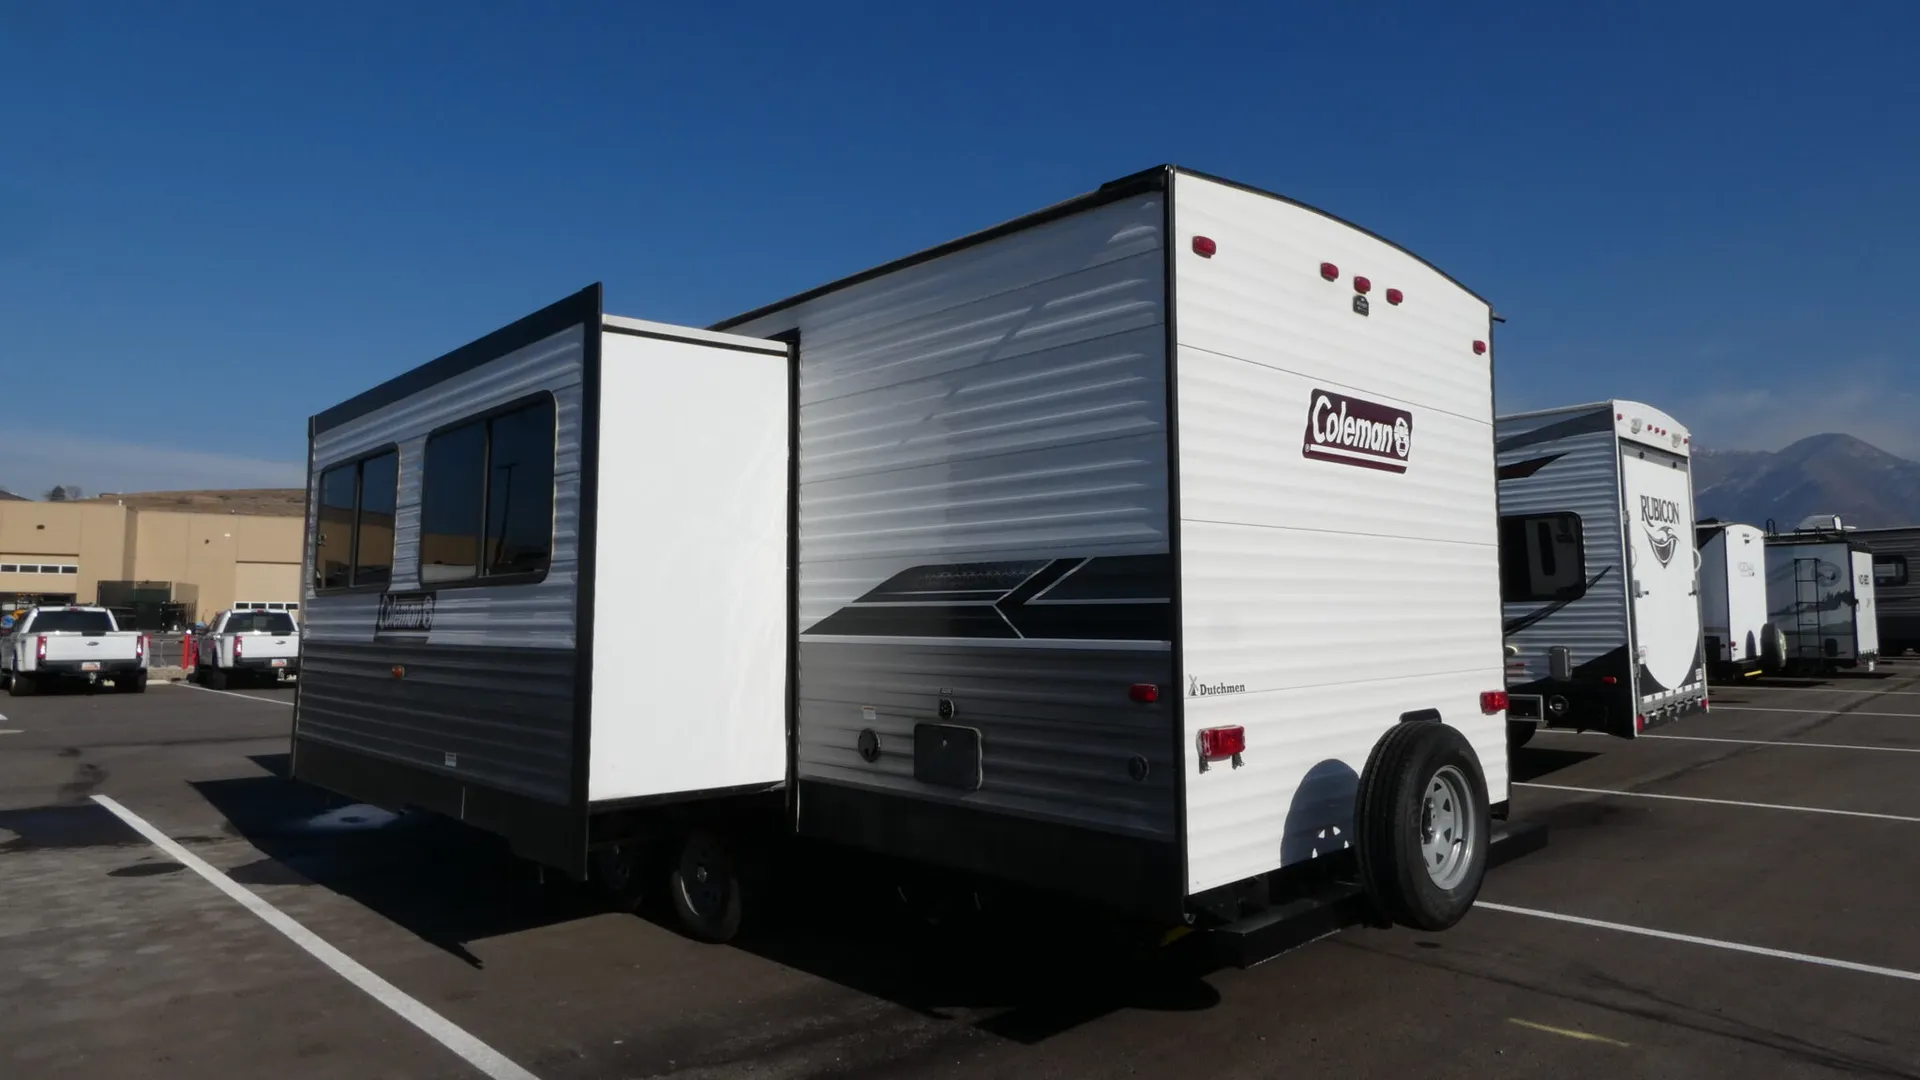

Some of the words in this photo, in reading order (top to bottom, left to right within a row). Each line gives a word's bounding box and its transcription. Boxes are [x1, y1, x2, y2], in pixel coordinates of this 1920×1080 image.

[1312, 395, 1393, 453] Coleman
[1640, 494, 1680, 527] RUBICON
[1199, 682, 1246, 696] Dutchmen
